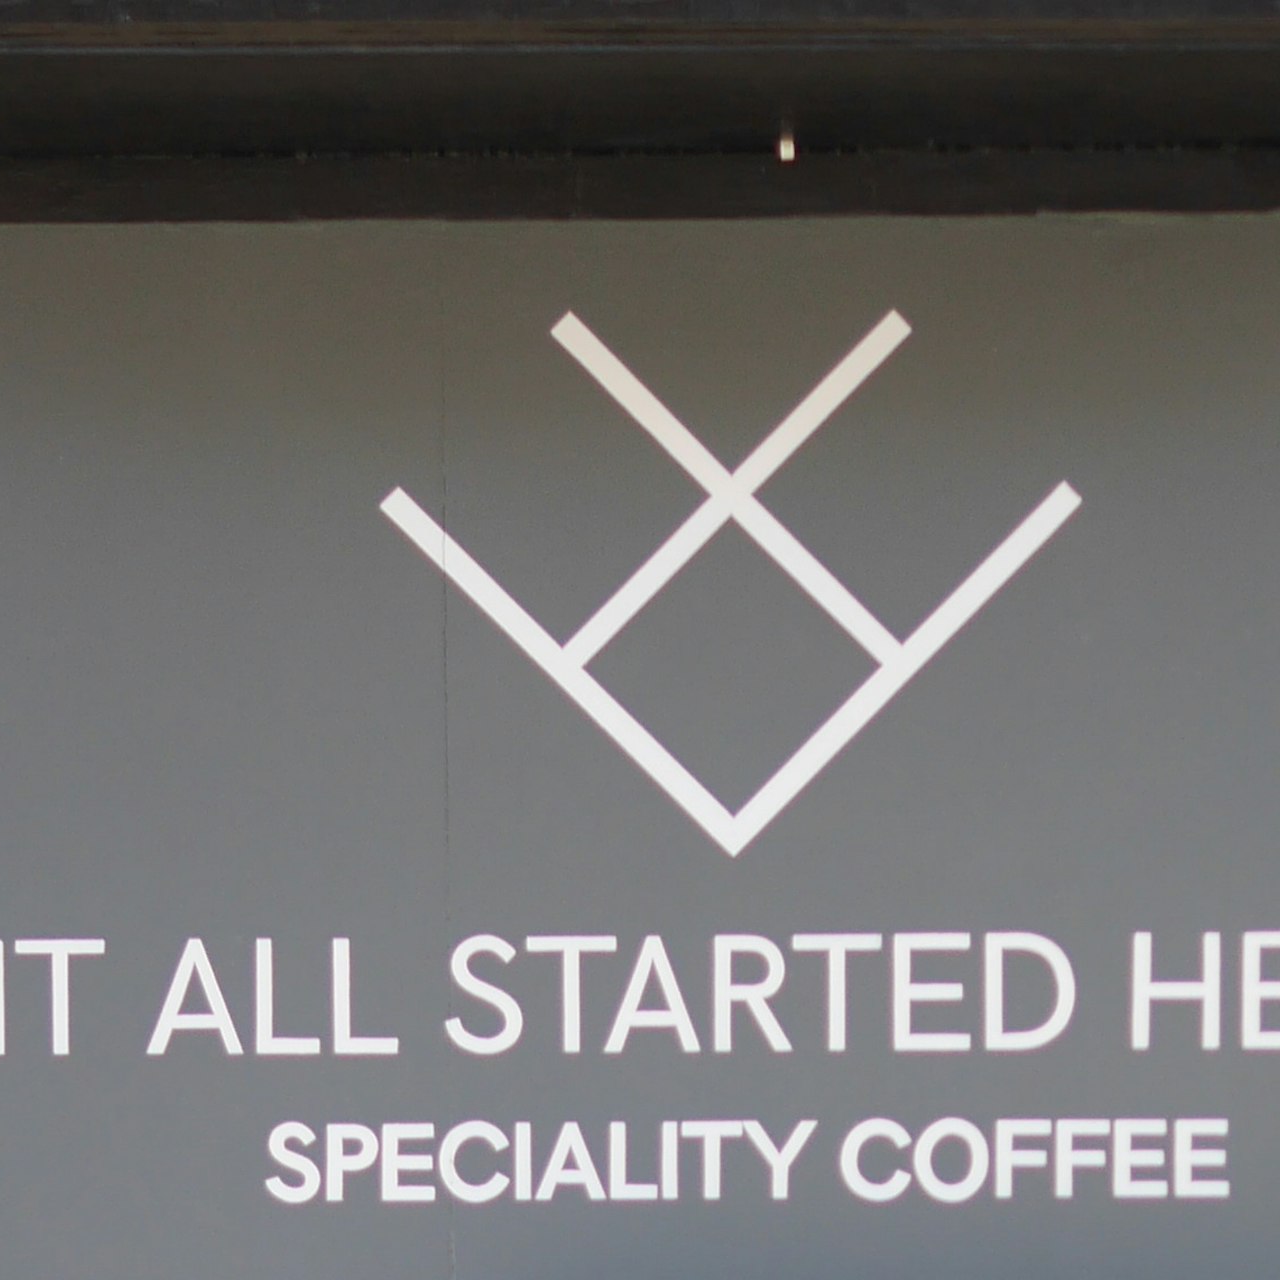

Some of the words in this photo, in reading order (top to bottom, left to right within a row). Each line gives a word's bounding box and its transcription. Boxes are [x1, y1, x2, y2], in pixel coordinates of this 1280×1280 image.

[146, 937, 400, 1056] ALL
[444, 931, 1076, 1055] STARTED
[264, 1119, 819, 1204] SPECIALITY
[839, 1116, 1230, 1204] COFFEE
